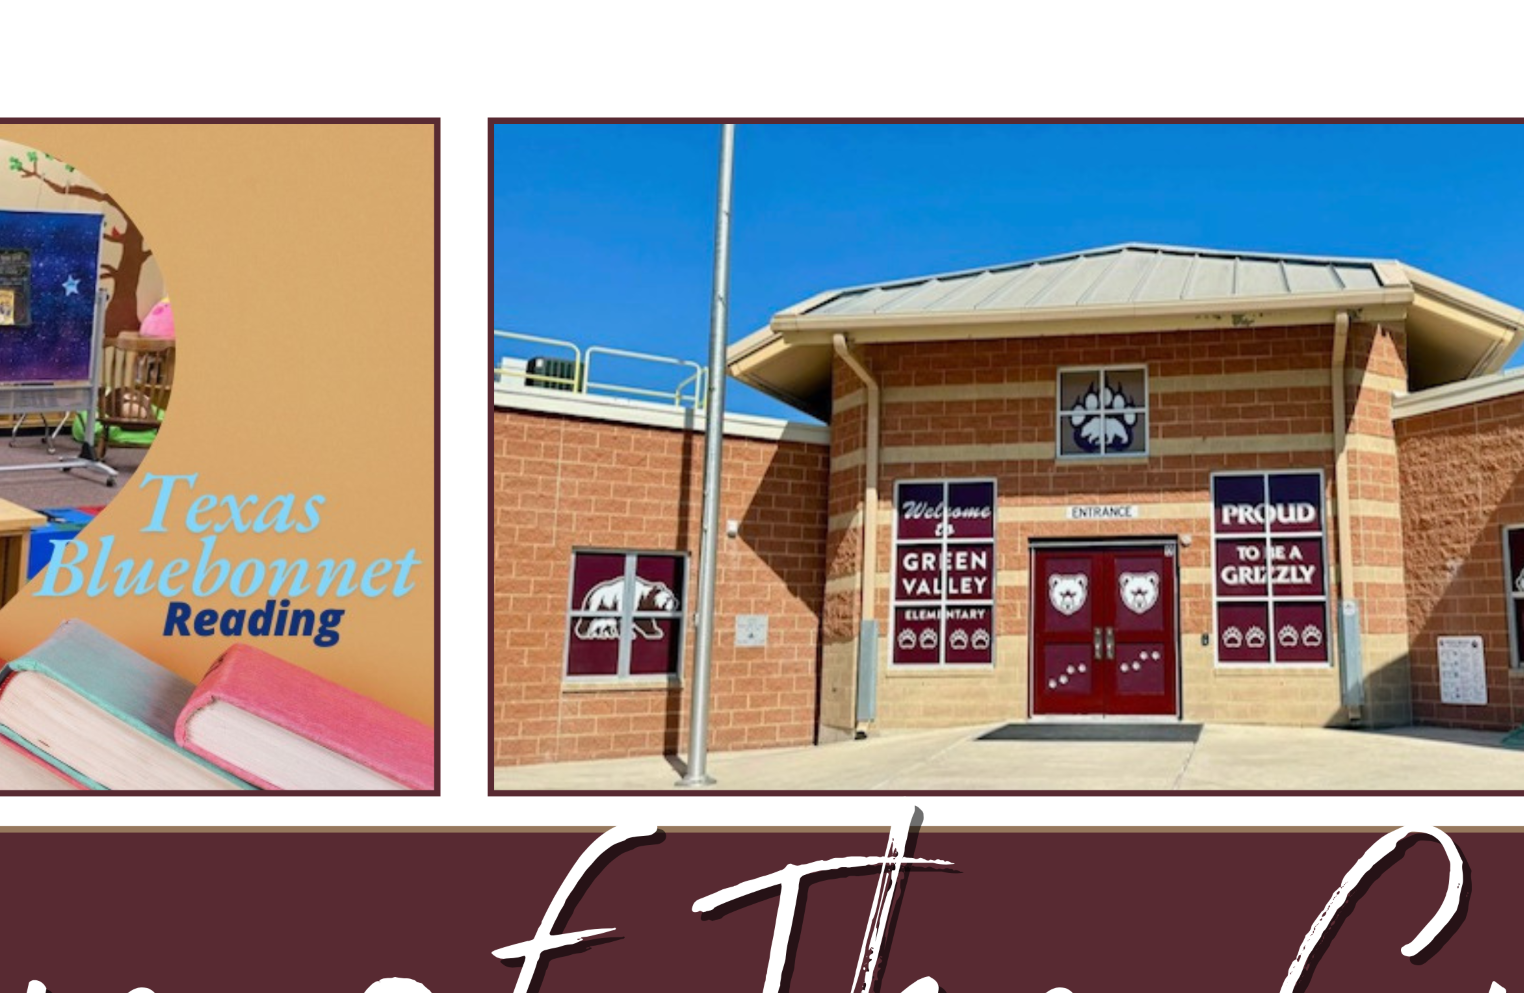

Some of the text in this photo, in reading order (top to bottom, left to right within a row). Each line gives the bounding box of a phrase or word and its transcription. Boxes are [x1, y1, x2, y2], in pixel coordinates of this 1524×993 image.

[1071, 507, 1132, 518] ENTRANCE
[1221, 503, 1316, 525] PROUD
[903, 551, 987, 571] GREEN
[1235, 546, 1260, 561] TO
[1287, 546, 1303, 561] A
[1220, 565, 1316, 585] GRIZZLY
[902, 577, 987, 595] VALLEY
